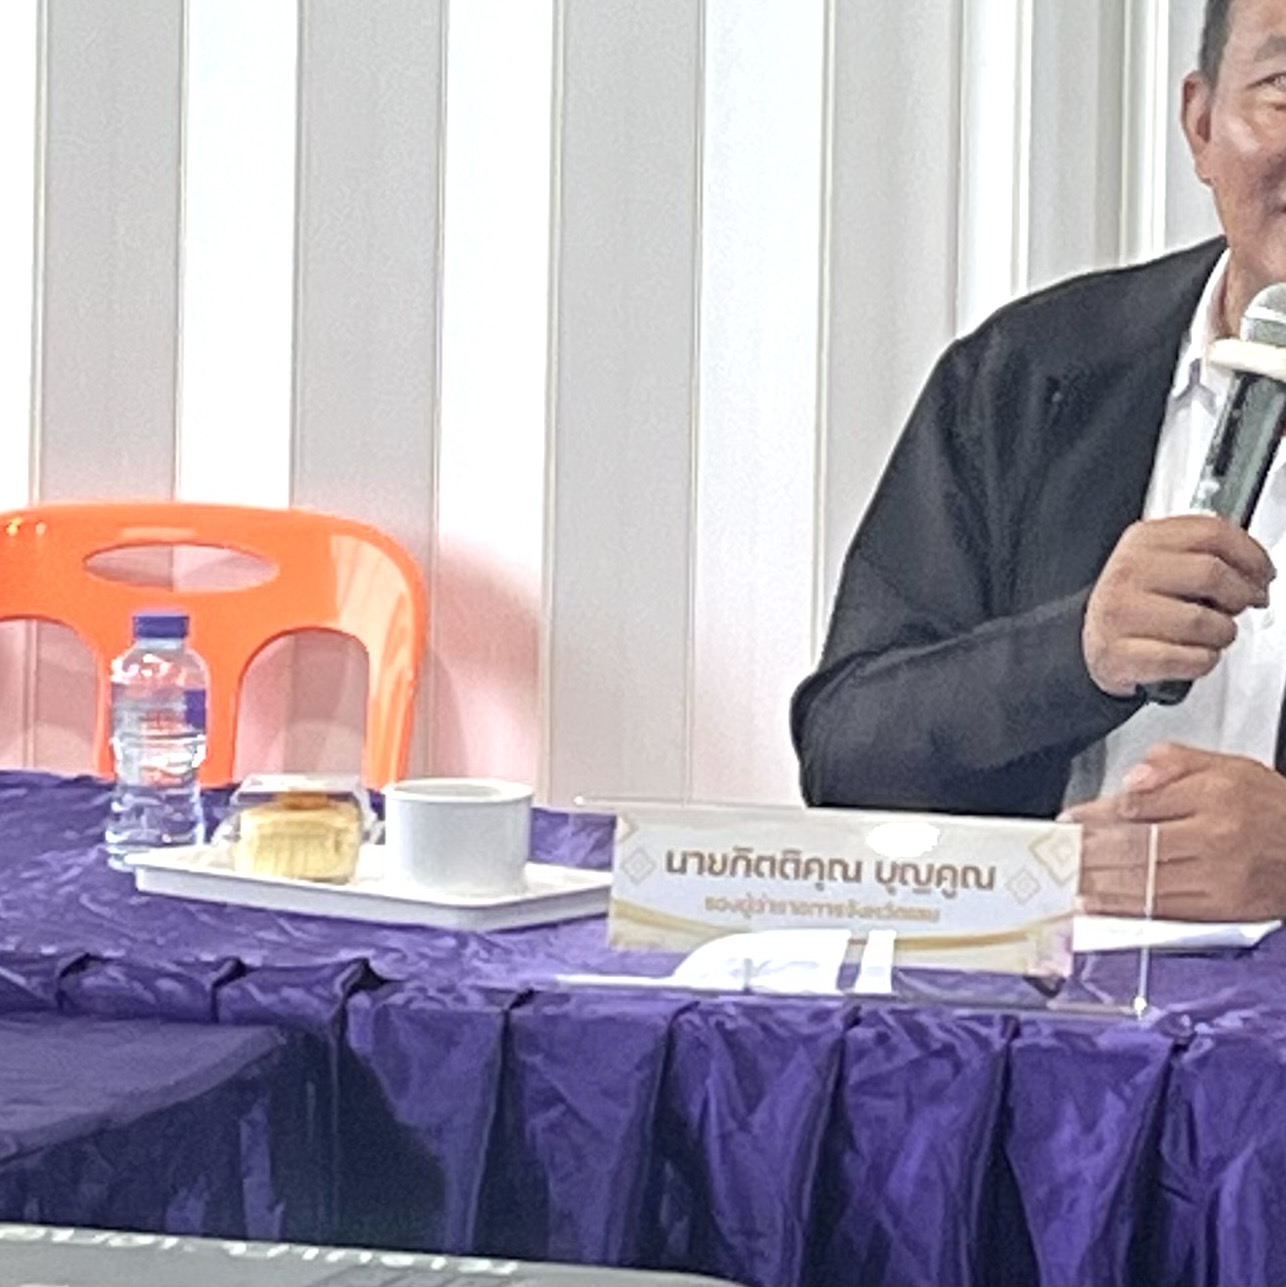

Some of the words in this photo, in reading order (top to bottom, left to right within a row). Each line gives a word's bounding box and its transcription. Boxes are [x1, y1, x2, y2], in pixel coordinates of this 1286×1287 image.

[666, 845, 862, 892] นายกิตติคุณ
[875, 860, 996, 899] บุญคูณ
